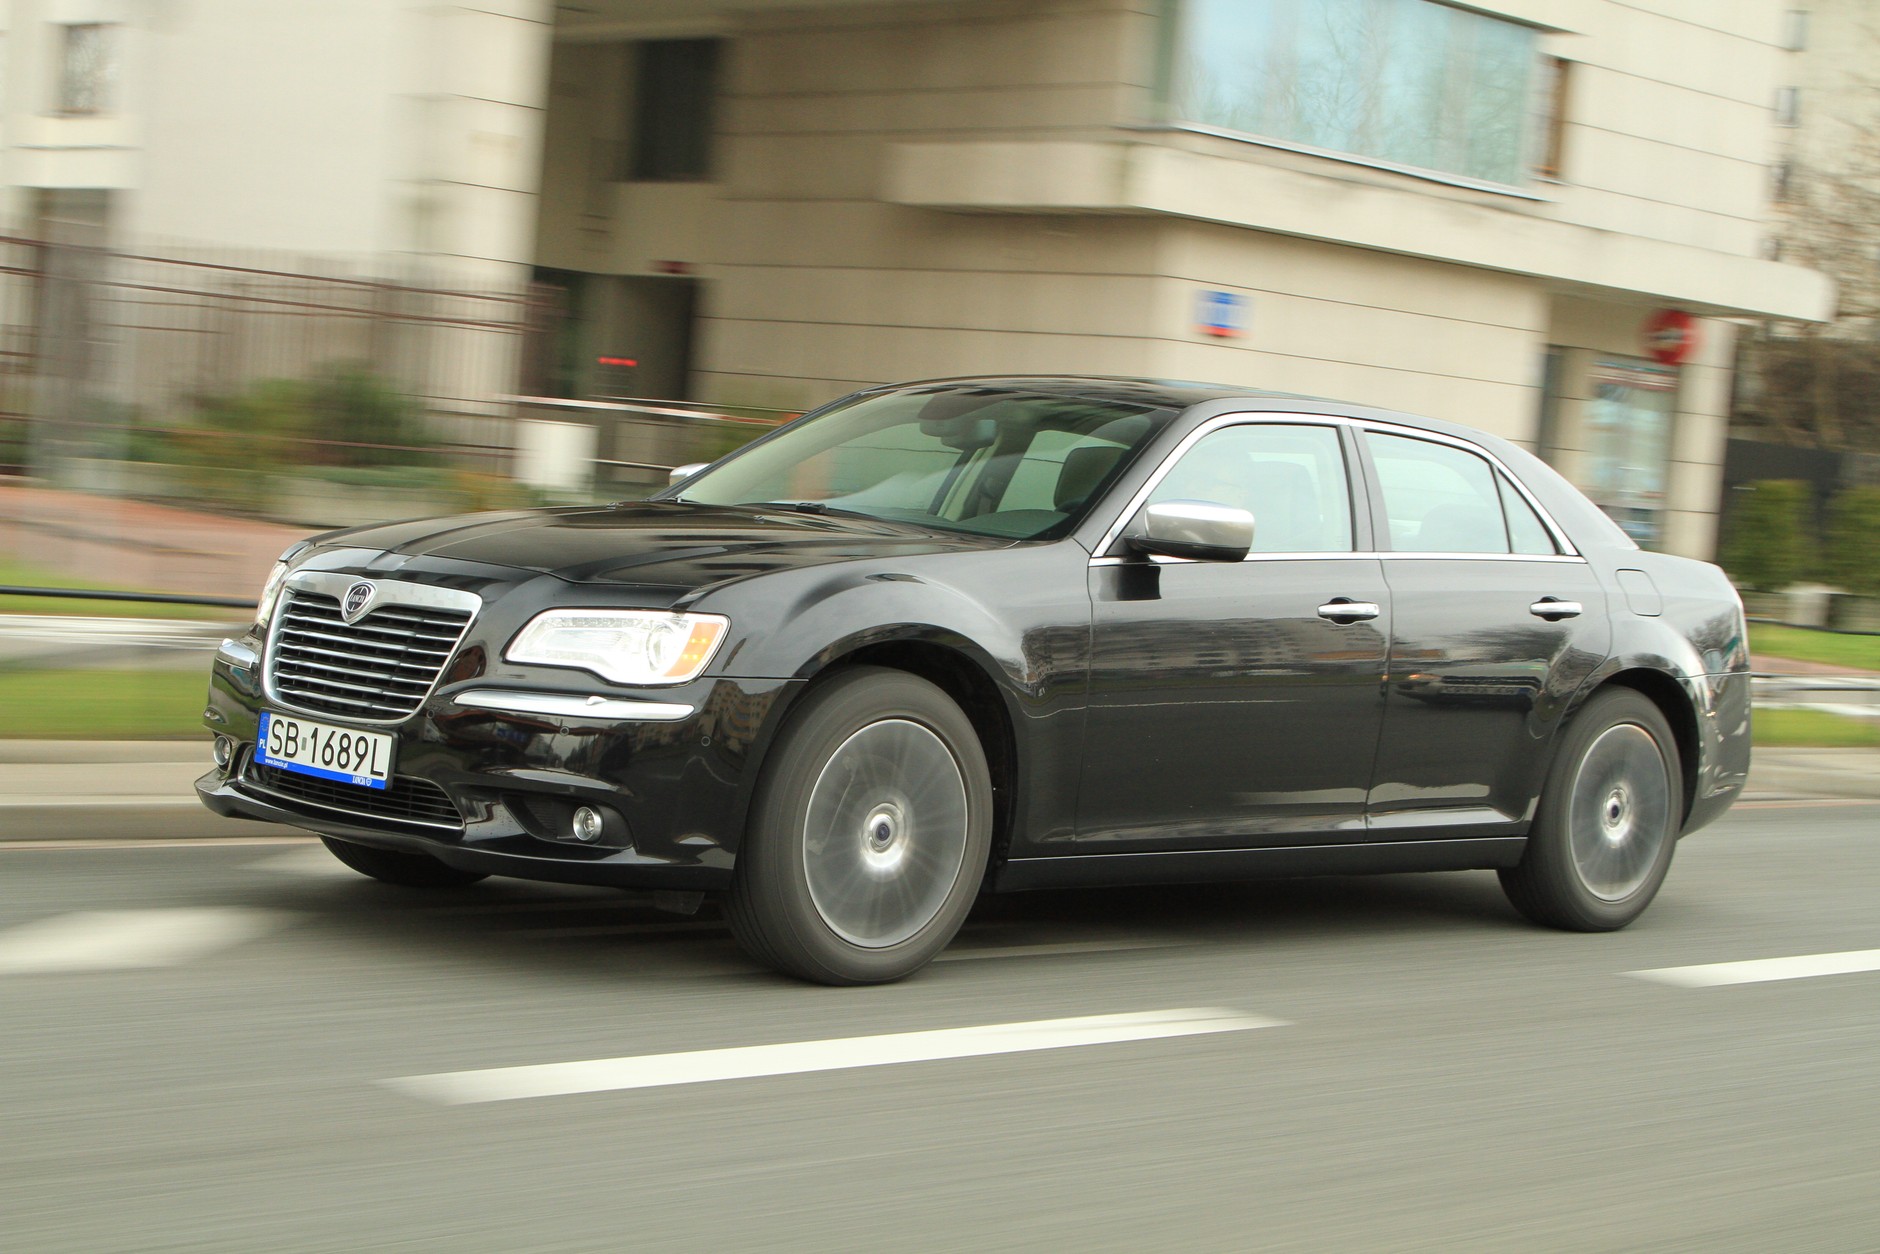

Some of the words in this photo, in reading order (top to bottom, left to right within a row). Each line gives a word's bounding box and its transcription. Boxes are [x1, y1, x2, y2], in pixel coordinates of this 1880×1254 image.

[259, 738, 266, 749] PL
[270, 719, 299, 758] SB
[310, 727, 384, 777] 1689L
